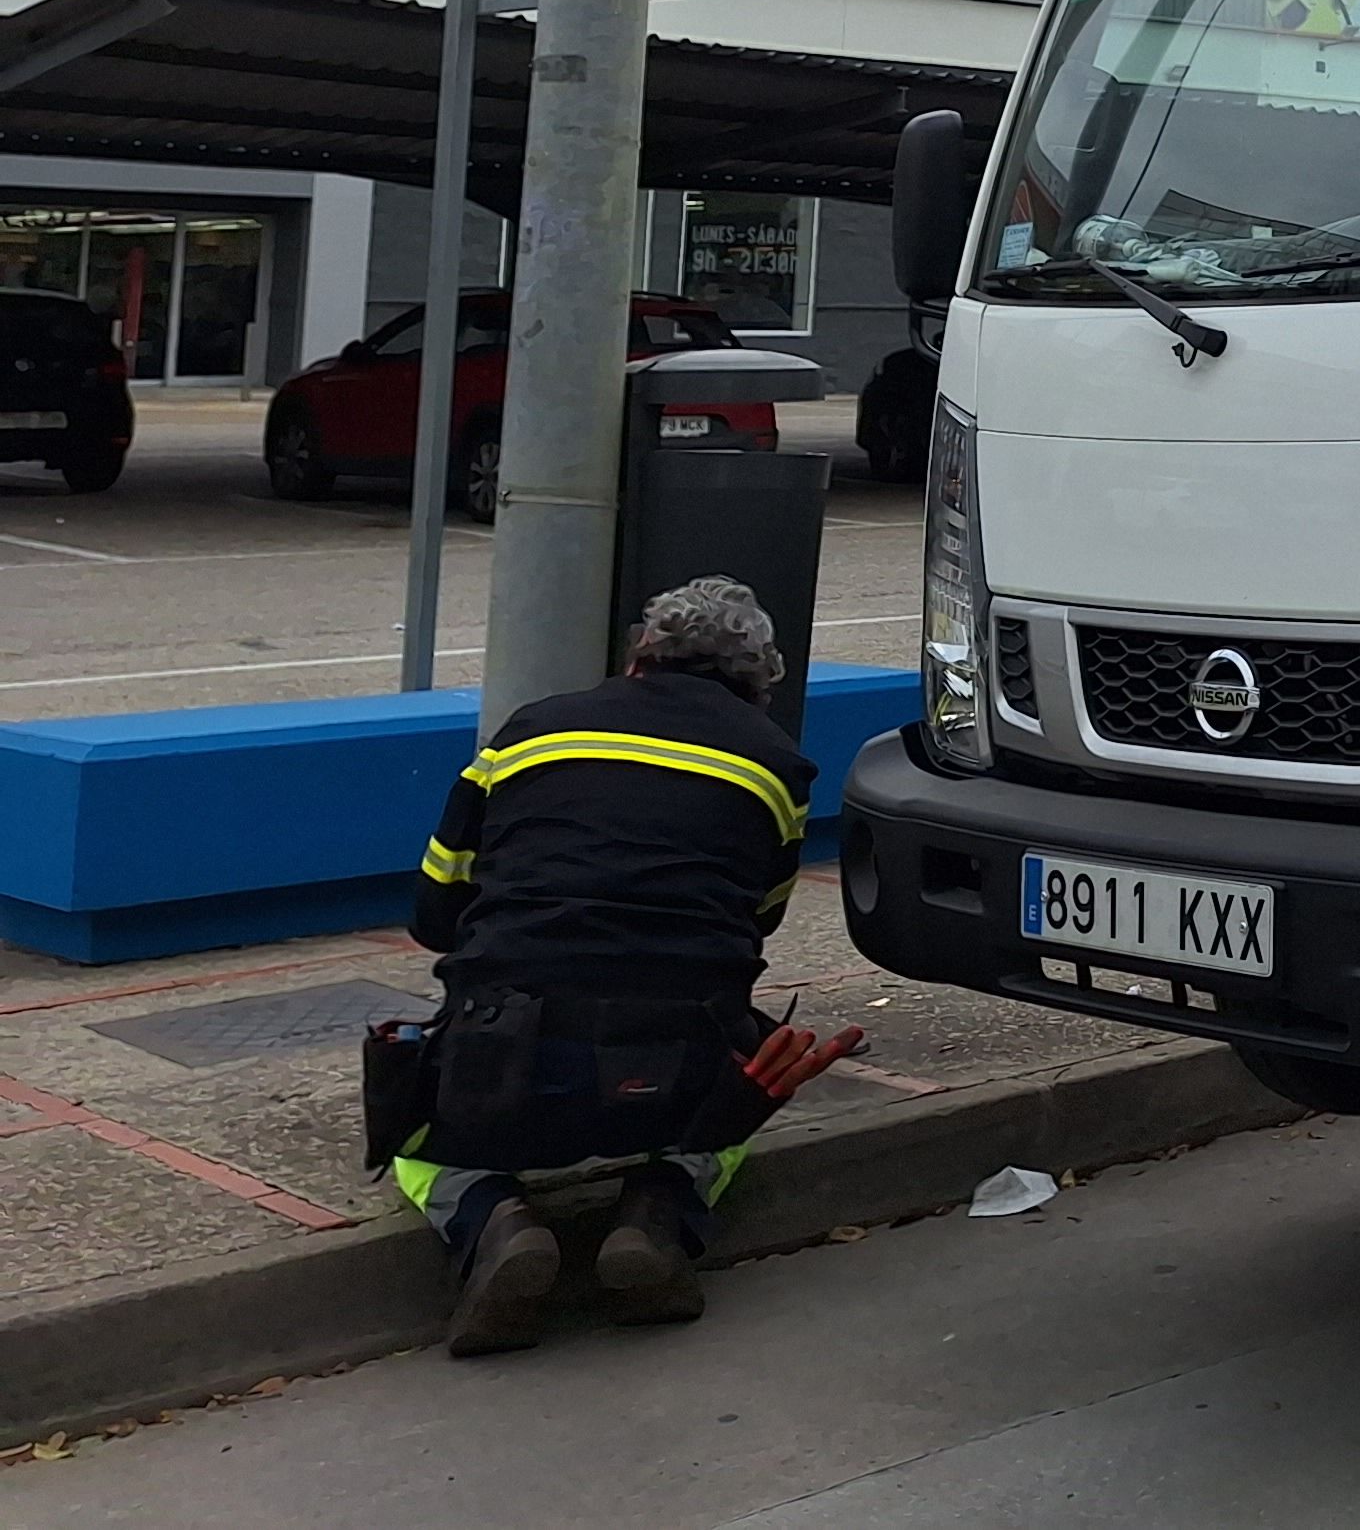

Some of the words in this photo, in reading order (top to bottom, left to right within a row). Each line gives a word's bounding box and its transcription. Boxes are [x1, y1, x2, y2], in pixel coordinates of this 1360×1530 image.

[1187, 688, 1249, 708] NISSAN
[1045, 869, 1145, 944] 8911
[1178, 886, 1266, 964] KXX
